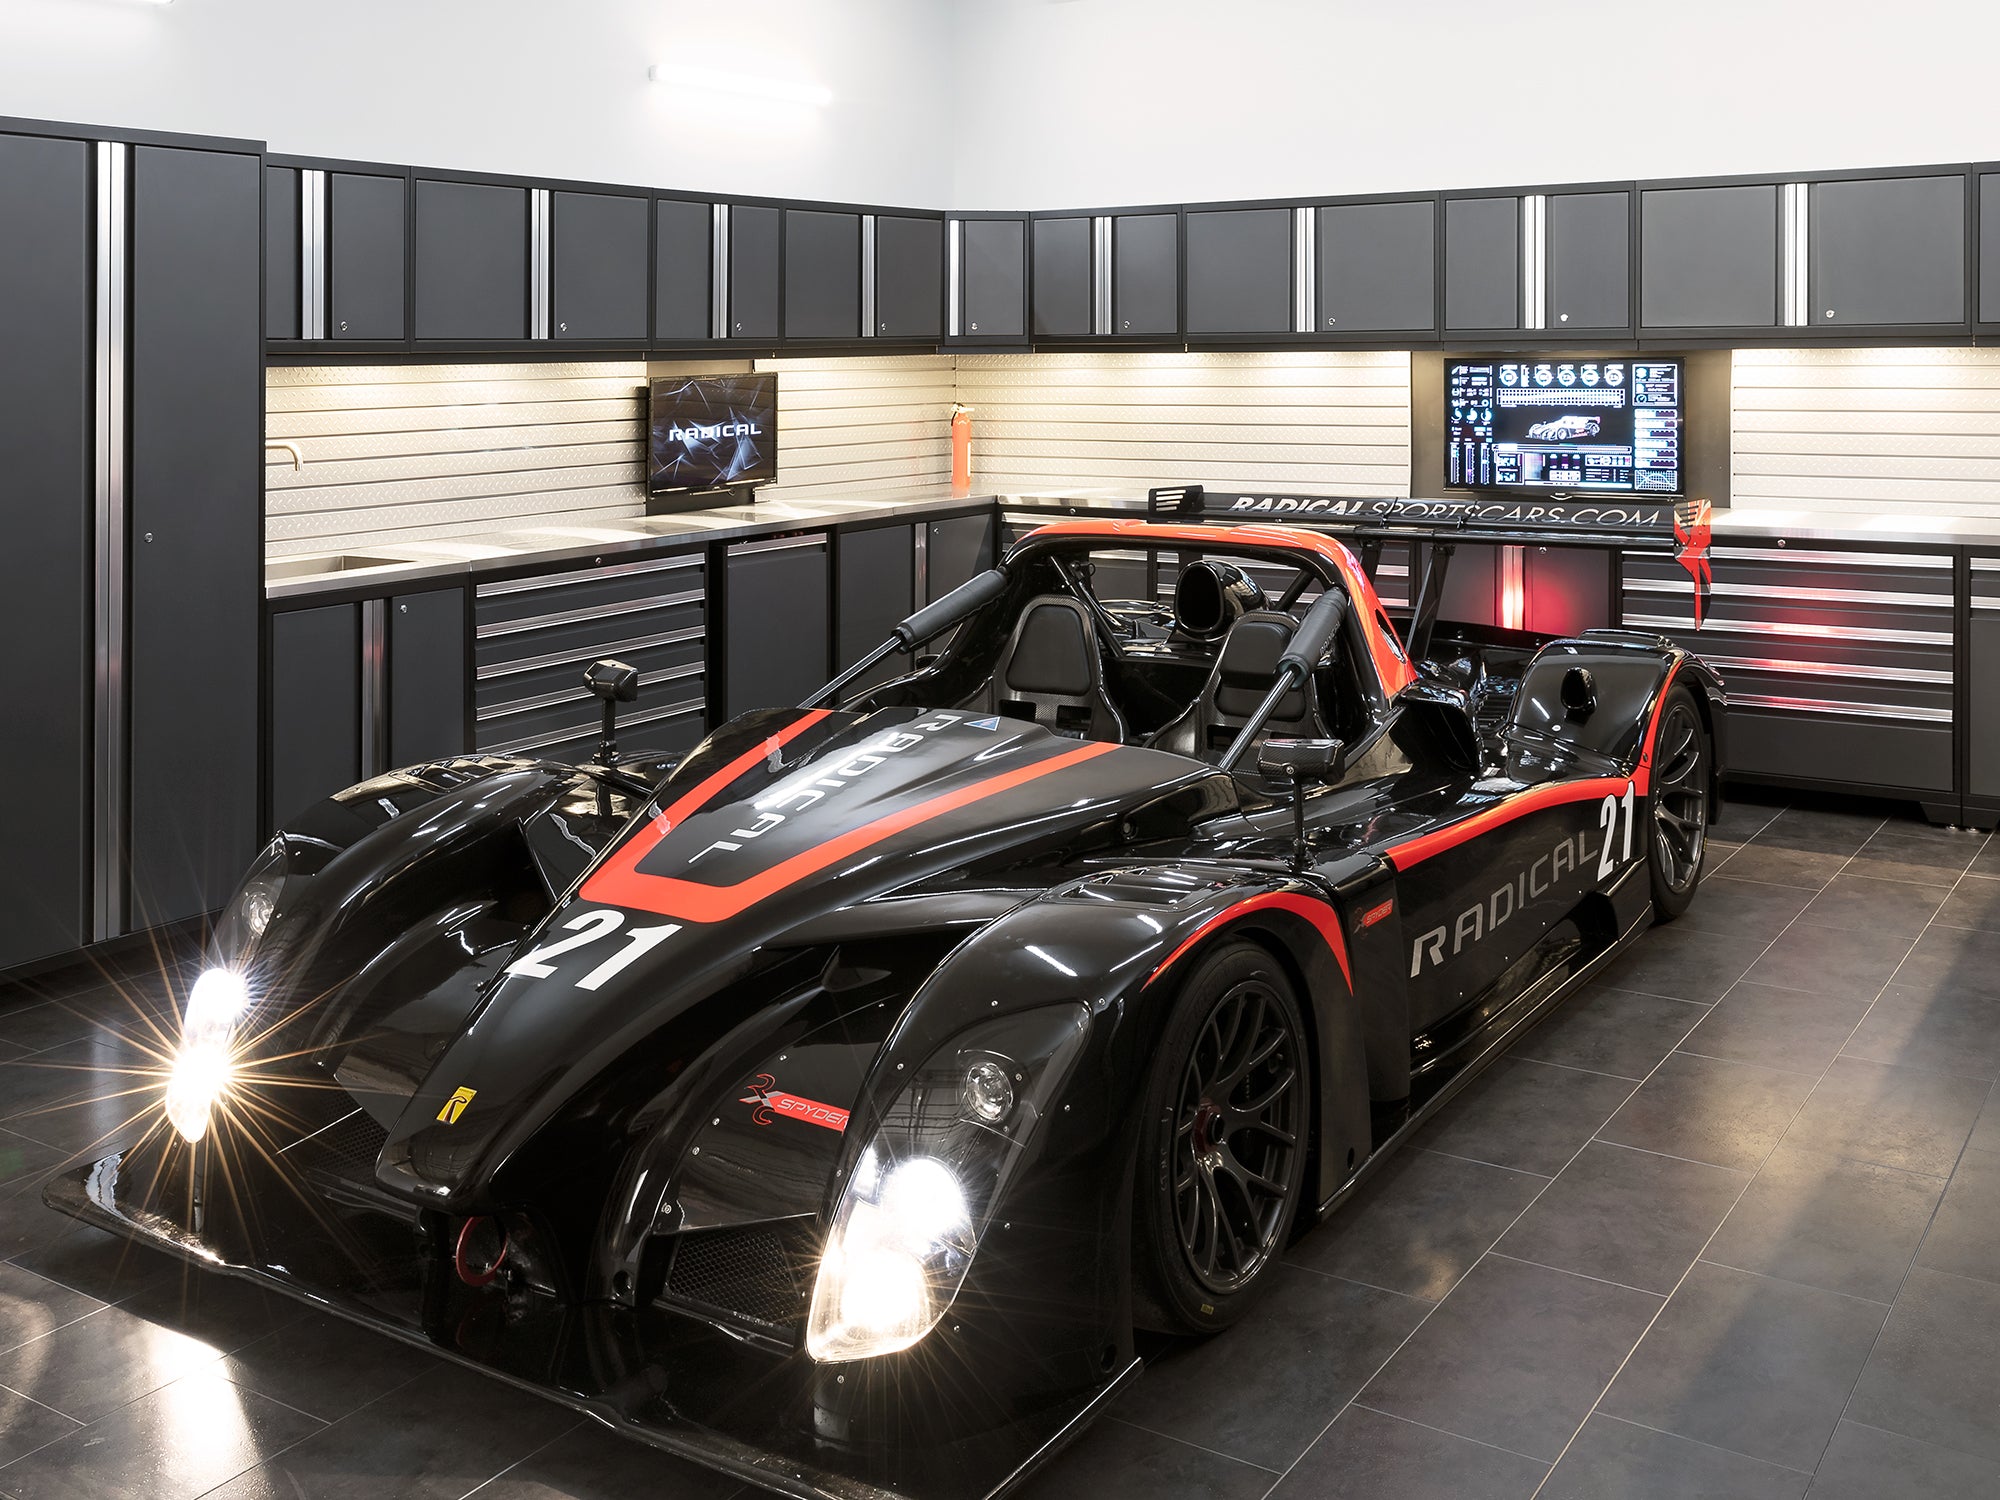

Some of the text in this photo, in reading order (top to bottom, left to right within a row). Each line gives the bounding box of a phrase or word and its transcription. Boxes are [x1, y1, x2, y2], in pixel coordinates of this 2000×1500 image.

[668, 422, 762, 442] RADICAL
[688, 714, 955, 864] RADICAL
[1597, 781, 1634, 882] 21
[503, 909, 683, 992] 21
[1410, 830, 1598, 978] RADICAL
